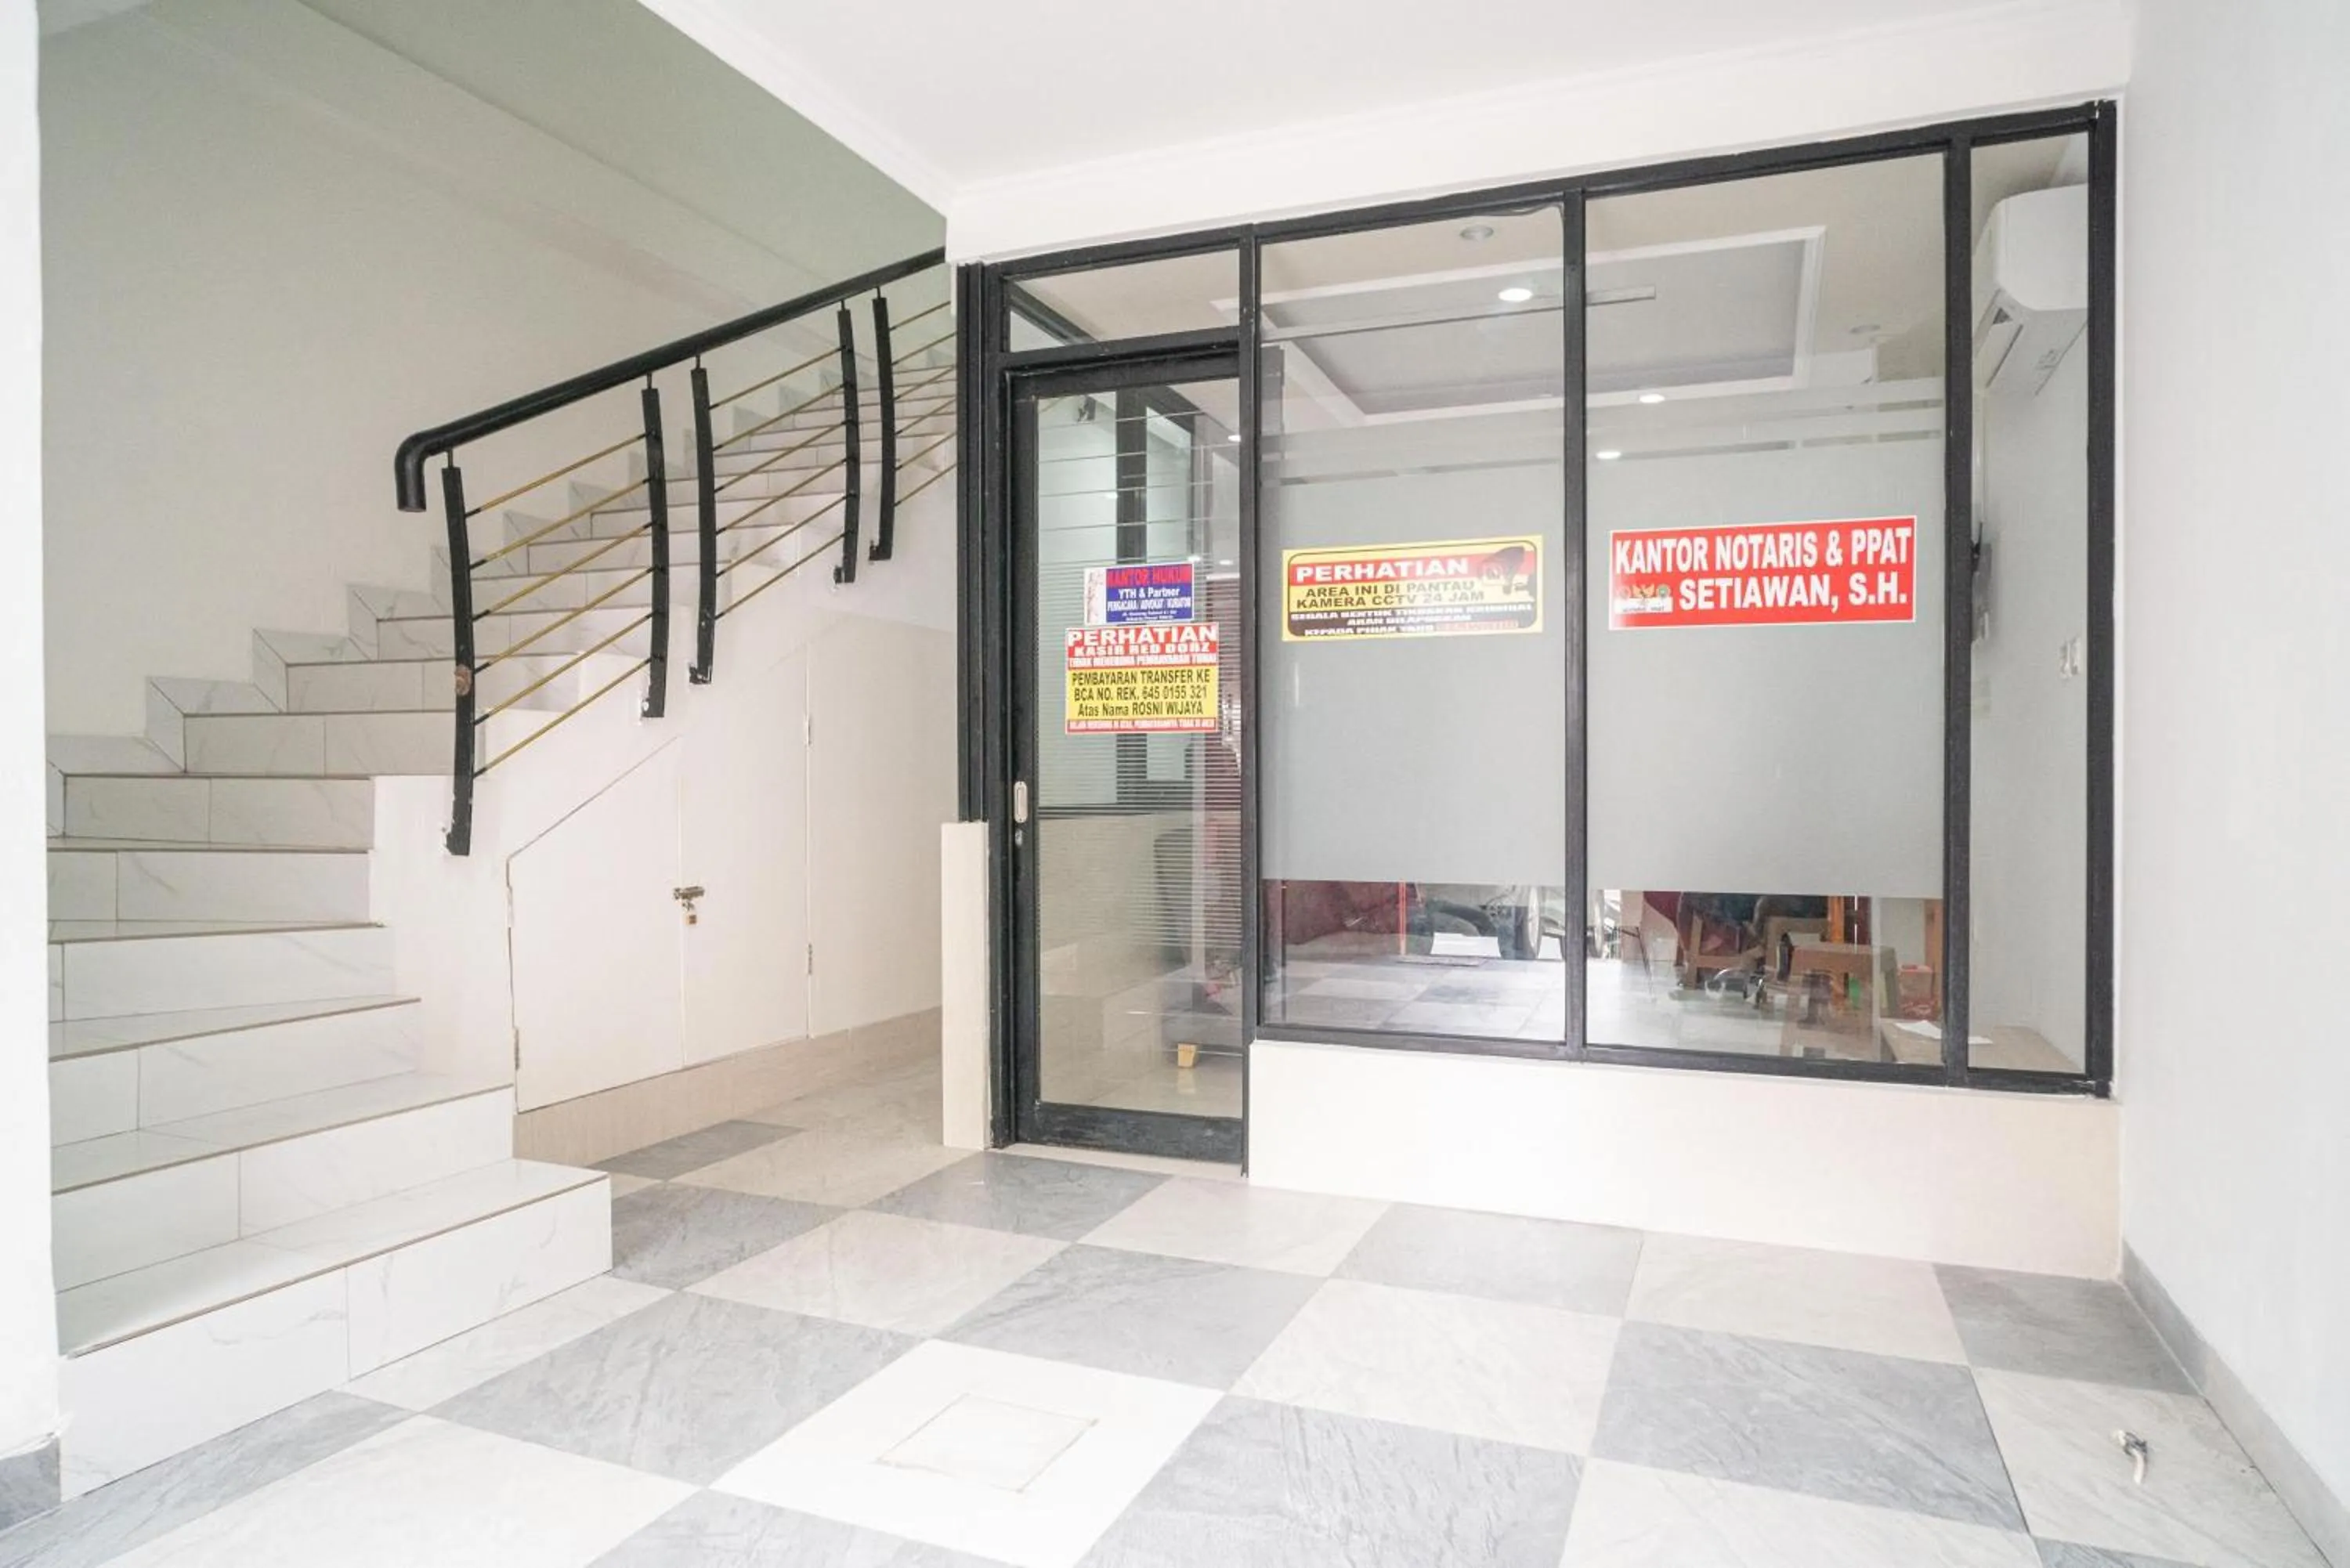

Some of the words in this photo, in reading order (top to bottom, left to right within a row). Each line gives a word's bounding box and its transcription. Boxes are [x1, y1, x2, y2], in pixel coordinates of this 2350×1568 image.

[1615, 536, 1708, 574] KANTOR
[1715, 531, 1818, 570] NOTARIS
[1825, 529, 1842, 566] &
[1851, 526, 1912, 565] PPAT
[1296, 558, 1469, 583] PERHATIAN
[1148, 587, 1180, 598] Partner
[1305, 586, 1349, 598] AREA
[1355, 585, 1378, 596] INI
[1384, 583, 1400, 594] DI
[1407, 580, 1475, 594] PANTAU
[1679, 573, 1839, 613] SETIAWAN,
[1849, 571, 1907, 605] S.H.
[1296, 596, 1366, 609] KAMERA
[1372, 594, 1418, 606] CCTV
[1423, 592, 1442, 604] 24
[1449, 591, 1484, 602] JAM
[1068, 626, 1217, 646] PERHATIAN
[1072, 671, 1136, 686] PEMBAYARAN
[1141, 670, 1192, 684] TRANSFER
[1197, 669, 1210, 683] KE
[1075, 688, 1094, 701] BCA
[1097, 687, 1113, 701] NO.
[1117, 687, 1139, 700] REK.
[1142, 686, 1159, 699] 645
[1078, 704, 1099, 717] Atas
[1102, 703, 1129, 717] Nama
[1133, 702, 1162, 716] ROSNI
[1166, 701, 1203, 715] WIJAYA
